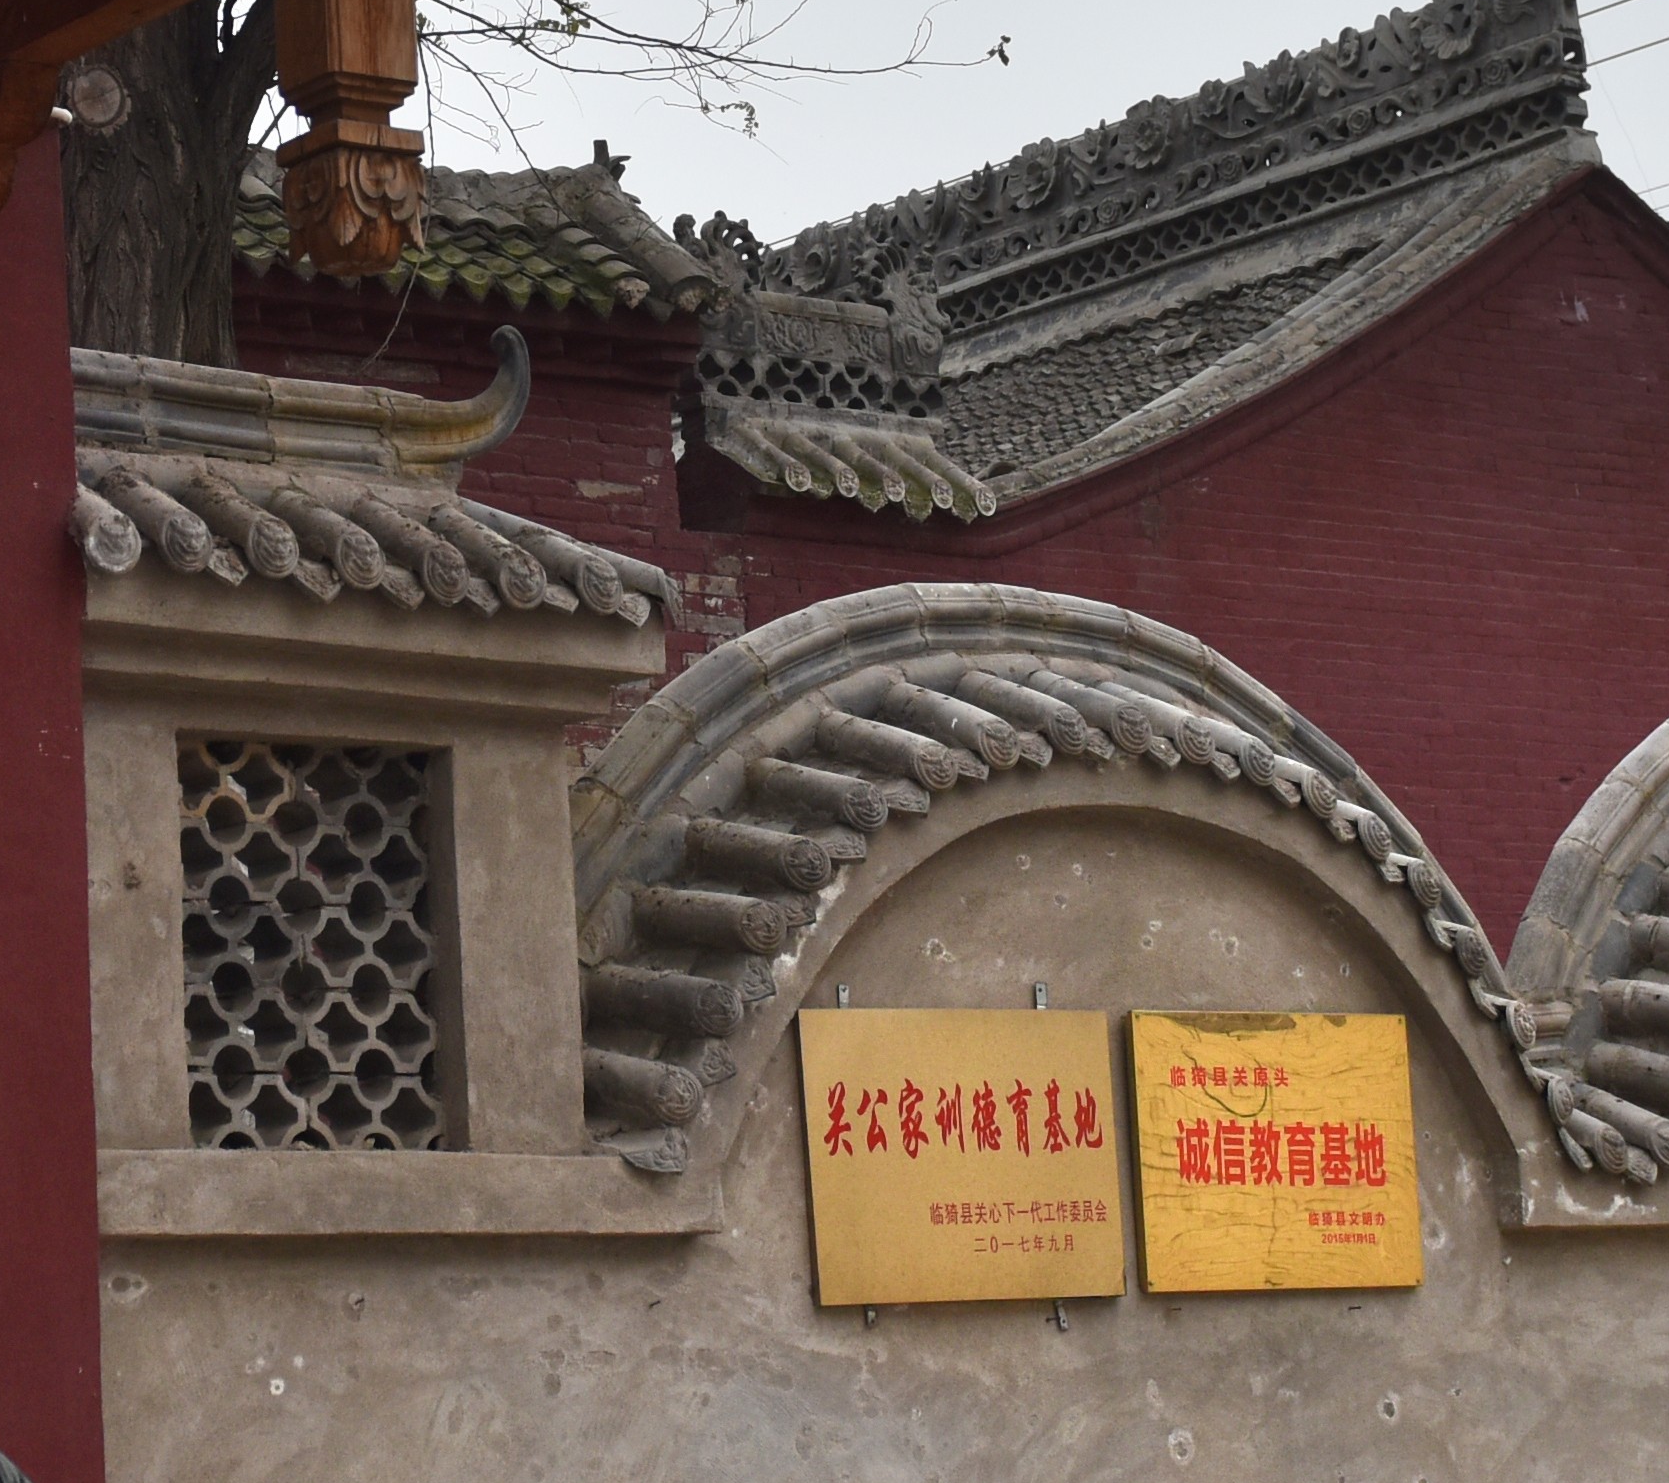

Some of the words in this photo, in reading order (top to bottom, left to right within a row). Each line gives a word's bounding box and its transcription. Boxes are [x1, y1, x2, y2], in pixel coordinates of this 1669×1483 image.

[1169, 1065, 1290, 1088] 临猗县关原头
[823, 1078, 1104, 1158] 关公家训德育基地
[1176, 1117, 1388, 1188] 诚信教育基地
[929, 1200, 1107, 1226] 临猗县关心下一代工作委员会
[1307, 1210, 1387, 1227] 临猗县文明办
